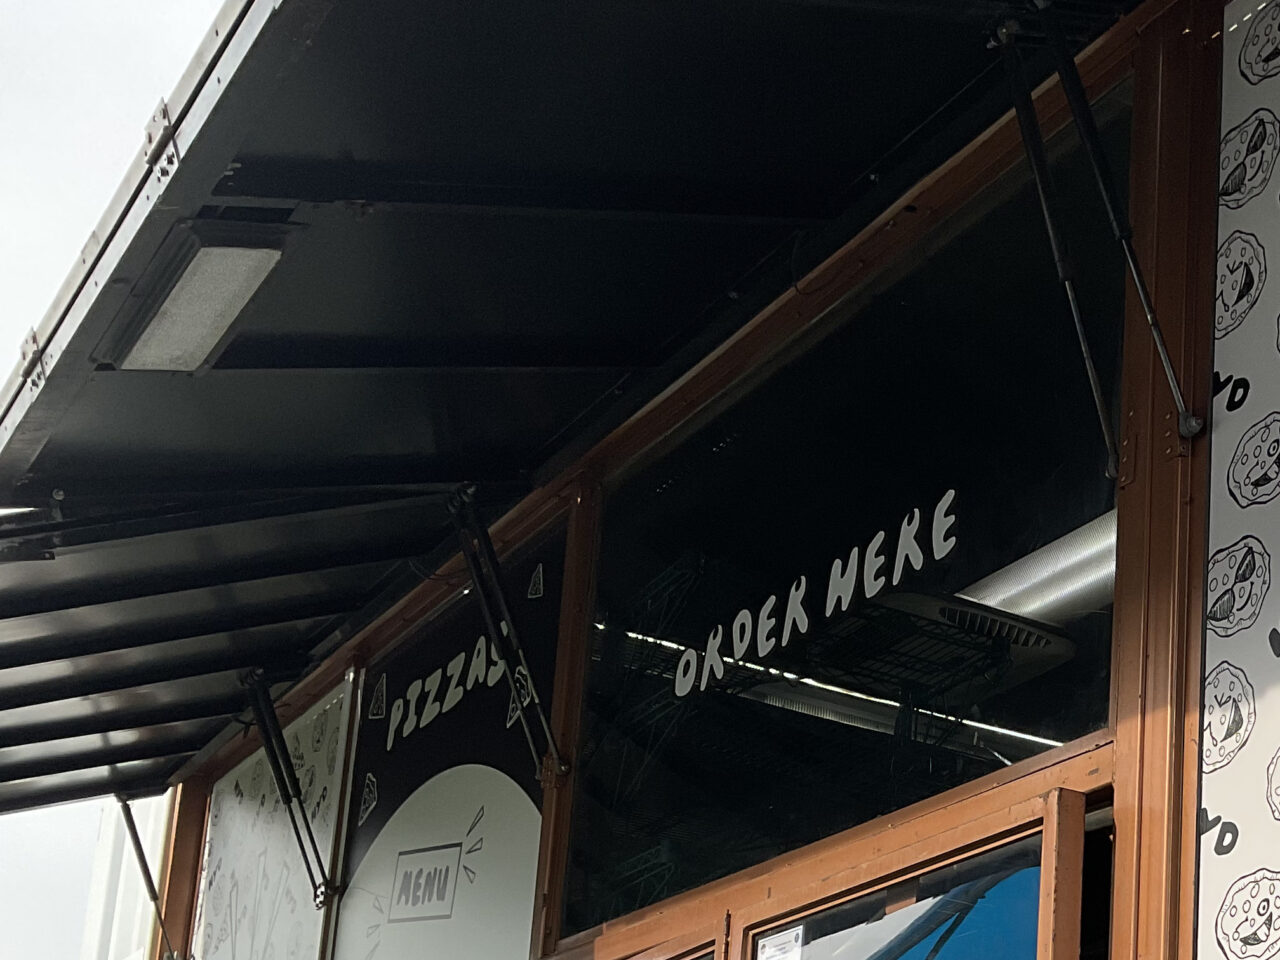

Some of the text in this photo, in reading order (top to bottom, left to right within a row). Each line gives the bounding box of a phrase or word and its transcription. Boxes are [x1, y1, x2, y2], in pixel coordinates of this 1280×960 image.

[675, 489, 956, 697] ORDER HERE
[396, 865, 449, 906] MENU
